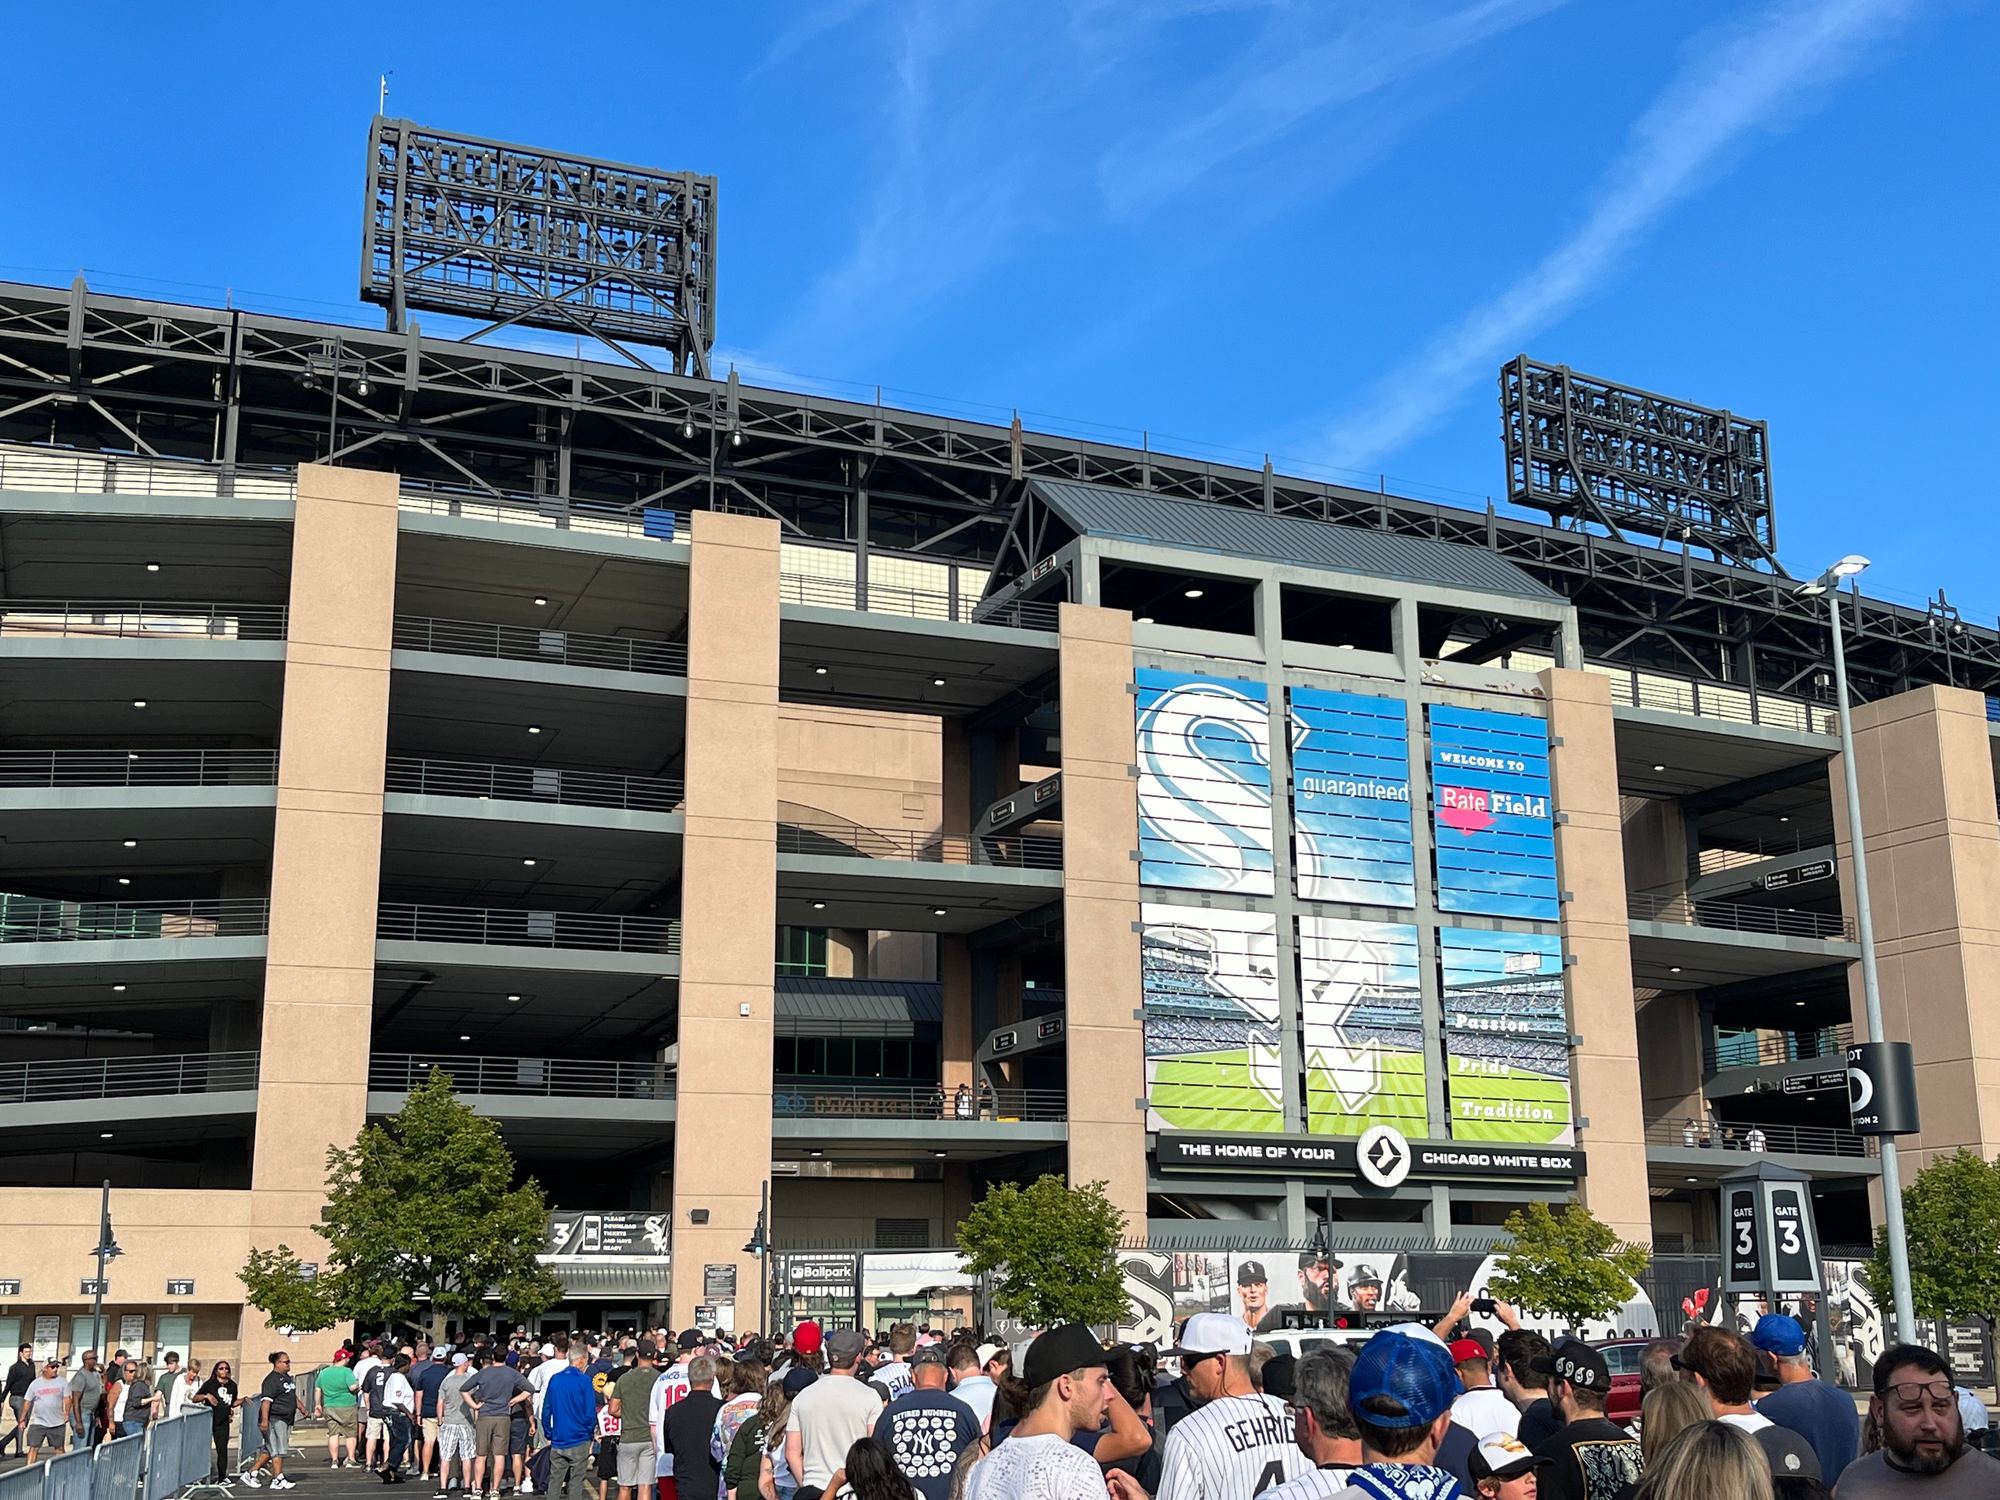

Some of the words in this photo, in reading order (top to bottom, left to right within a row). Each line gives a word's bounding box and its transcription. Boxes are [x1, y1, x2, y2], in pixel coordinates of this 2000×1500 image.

[1440, 752, 1505, 769] WELCOME
[1507, 760, 1525, 772] TO
[1303, 776, 1409, 801] guaranteed
[1443, 788, 1485, 811] Rate
[1491, 793, 1546, 817] Field
[1455, 1013, 1529, 1033] Passion
[1458, 1057, 1510, 1074] Pride
[1461, 1101, 1554, 1120] Tradition
[1872, 1116, 1879, 1124] 2
[1179, 1143, 1212, 1156] THE
[1215, 1145, 1263, 1158] HOME
[1265, 1146, 1287, 1159] OF
[1290, 1147, 1335, 1161] YOUR
[1422, 1152, 1490, 1166] CHICAGO
[1492, 1155, 1538, 1168] WHITE
[1541, 1157, 1572, 1169] SOX
[1733, 1207, 1753, 1218] GATE
[1774, 1206, 1798, 1216] GATE
[552, 1222, 570, 1245] 3
[1735, 1221, 1753, 1255] 3
[1778, 1220, 1801, 1255] 3
[804, 1266, 852, 1279] Ballpark
[173, 1284, 187, 1295] 15
[922, 1409, 957, 1419] NUMBERS
[1224, 1416, 1297, 1453] GEHRIG
